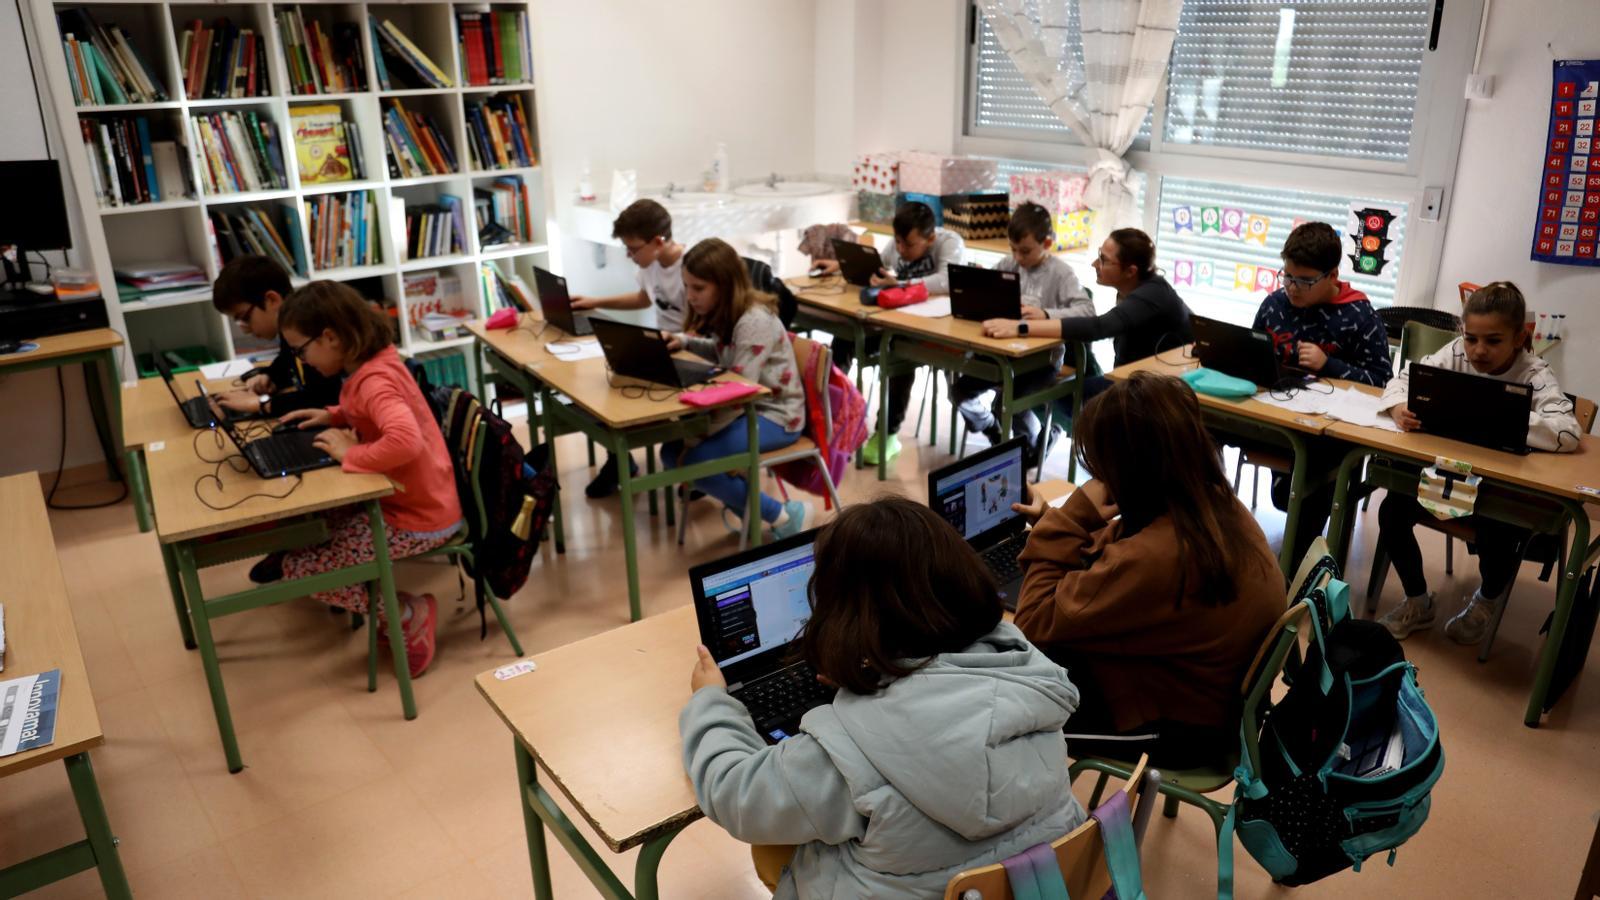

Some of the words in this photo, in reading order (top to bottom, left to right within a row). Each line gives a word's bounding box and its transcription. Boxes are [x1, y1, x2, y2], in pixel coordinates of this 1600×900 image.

[1583, 104, 1592, 112] 12
[1580, 123, 1590, 131] 22
[1554, 141, 1565, 149] 31
[1577, 141, 1587, 149] 32
[1551, 158, 1560, 166] 41
[1574, 159, 1585, 167] 42
[1546, 209, 1555, 217] 71
[20, 679, 50, 743] Innovamat
